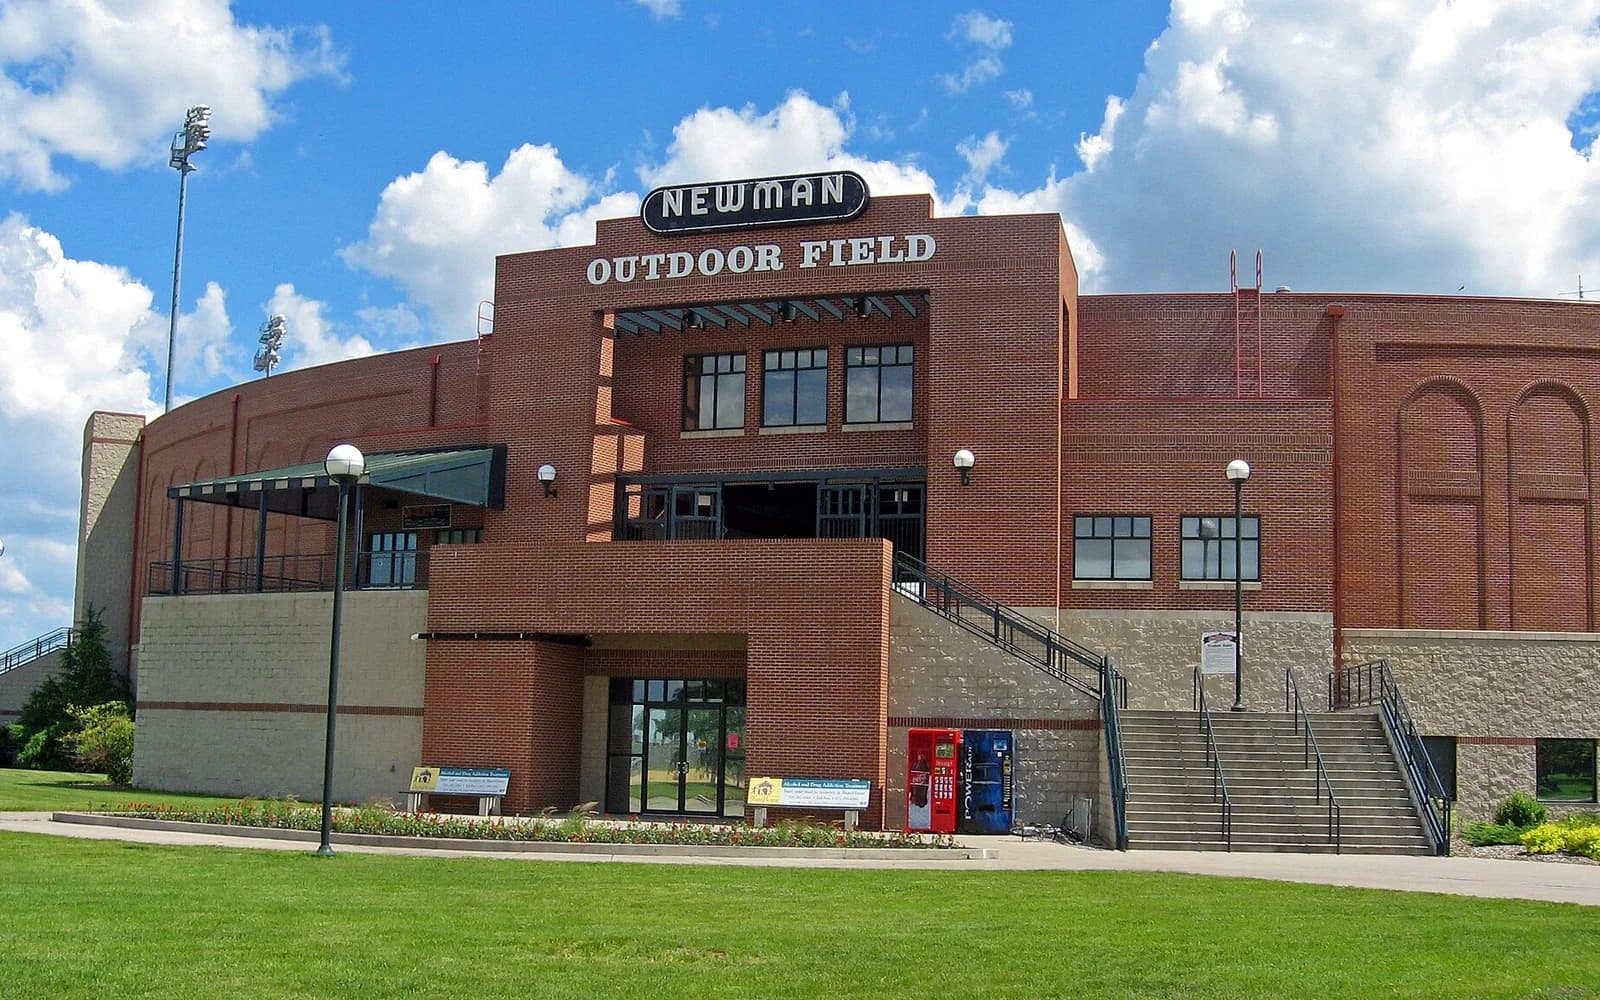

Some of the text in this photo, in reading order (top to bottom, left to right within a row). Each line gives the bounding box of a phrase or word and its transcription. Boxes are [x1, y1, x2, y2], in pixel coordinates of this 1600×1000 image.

[662, 174, 844, 217] NEWMAN
[586, 234, 937, 286] OUTDOOR FIELD
